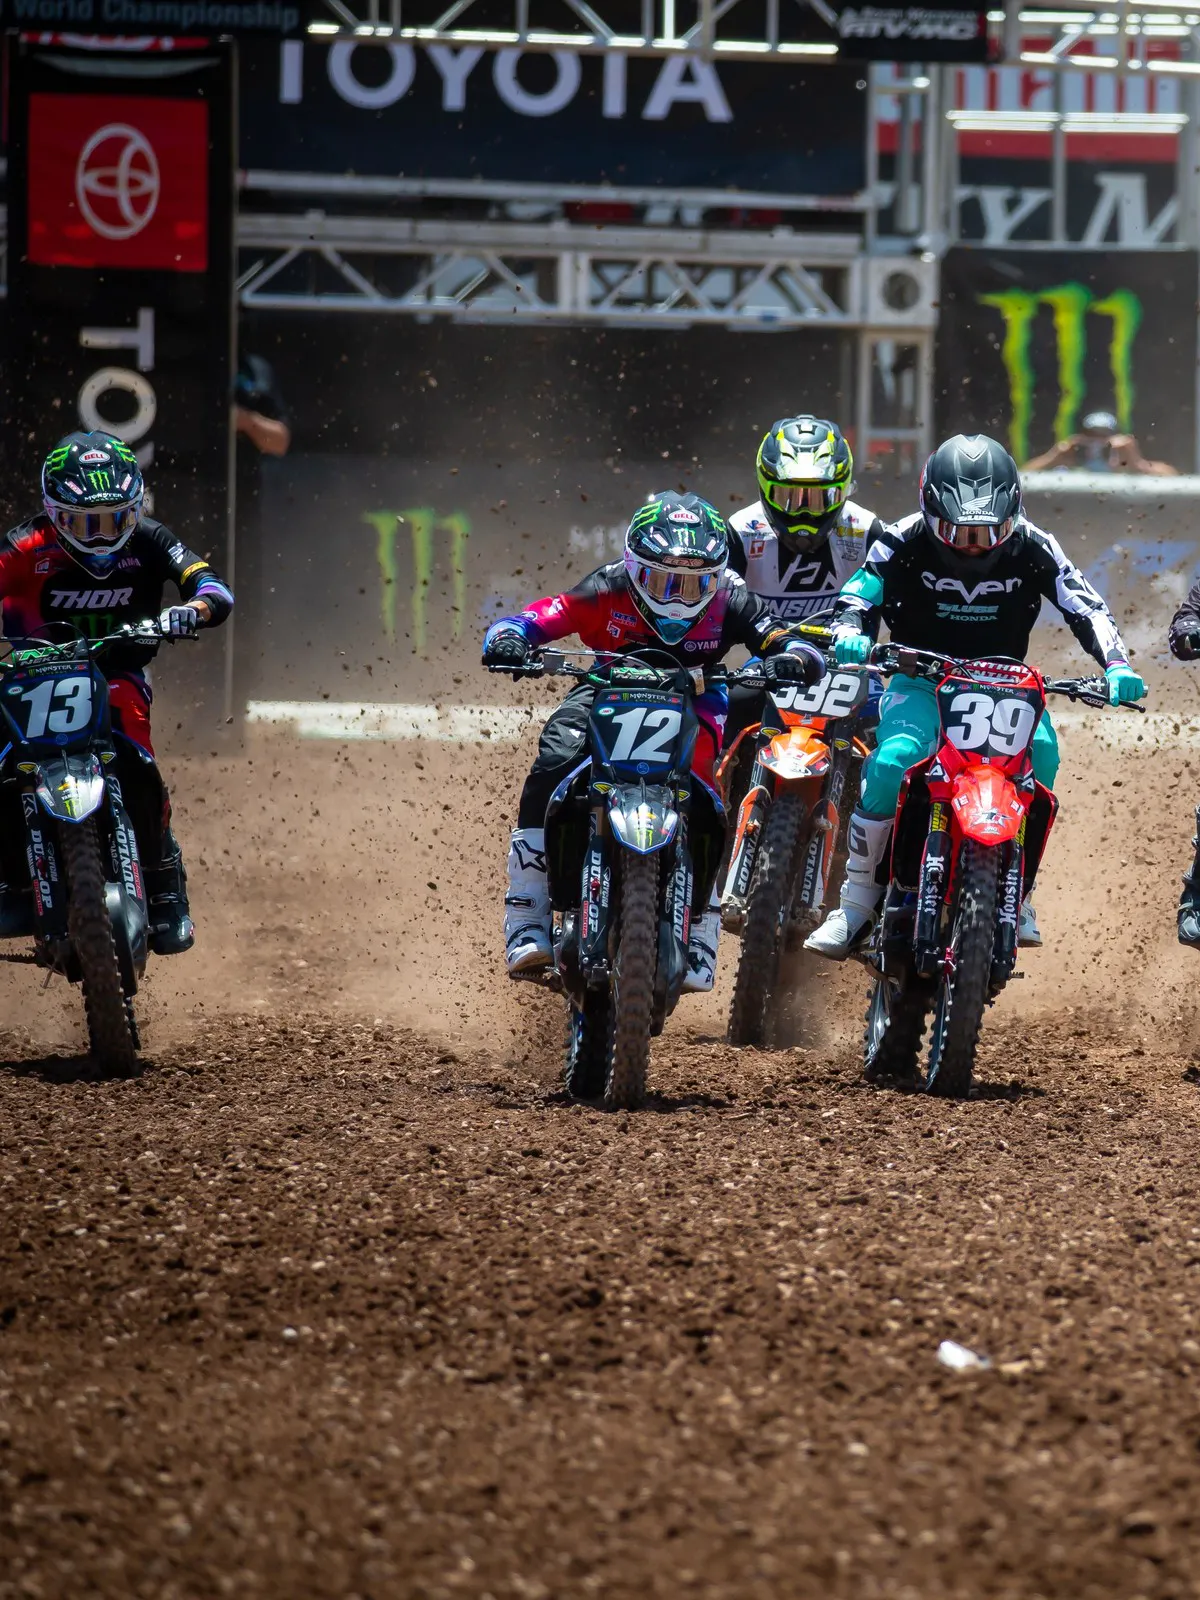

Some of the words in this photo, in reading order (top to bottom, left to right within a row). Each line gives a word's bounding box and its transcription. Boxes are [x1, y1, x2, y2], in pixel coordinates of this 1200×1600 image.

[280, 38, 734, 123] TOYOTA
[83, 452, 105, 461] BELL
[673, 512, 695, 521] BELL
[50, 586, 133, 609] THOR
[949, 614, 998, 622] HONDA
[36, 664, 72, 674] MONSTER
[979, 684, 1014, 695] MONSTER
[629, 692, 667, 702] MONSTER
[21, 676, 93, 739] 13
[946, 692, 1037, 757] 39
[610, 707, 683, 763] 12
